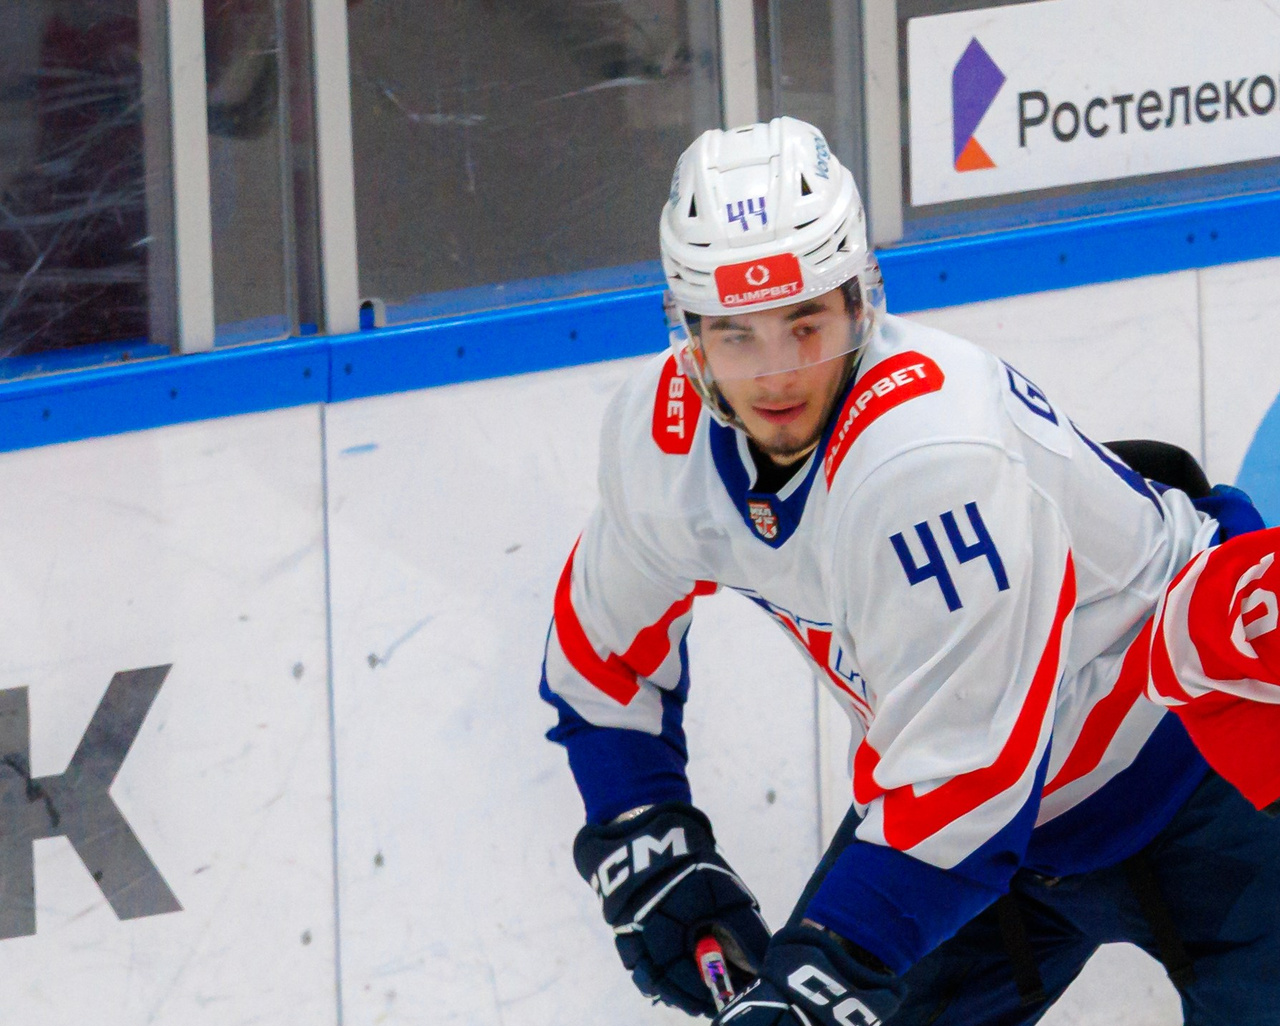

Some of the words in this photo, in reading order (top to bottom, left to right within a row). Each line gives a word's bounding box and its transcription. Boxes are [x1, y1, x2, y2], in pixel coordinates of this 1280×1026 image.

[726, 196, 769, 231] 44
[724, 281, 799, 305] OLIMPBET
[889, 501, 1010, 613] 44
